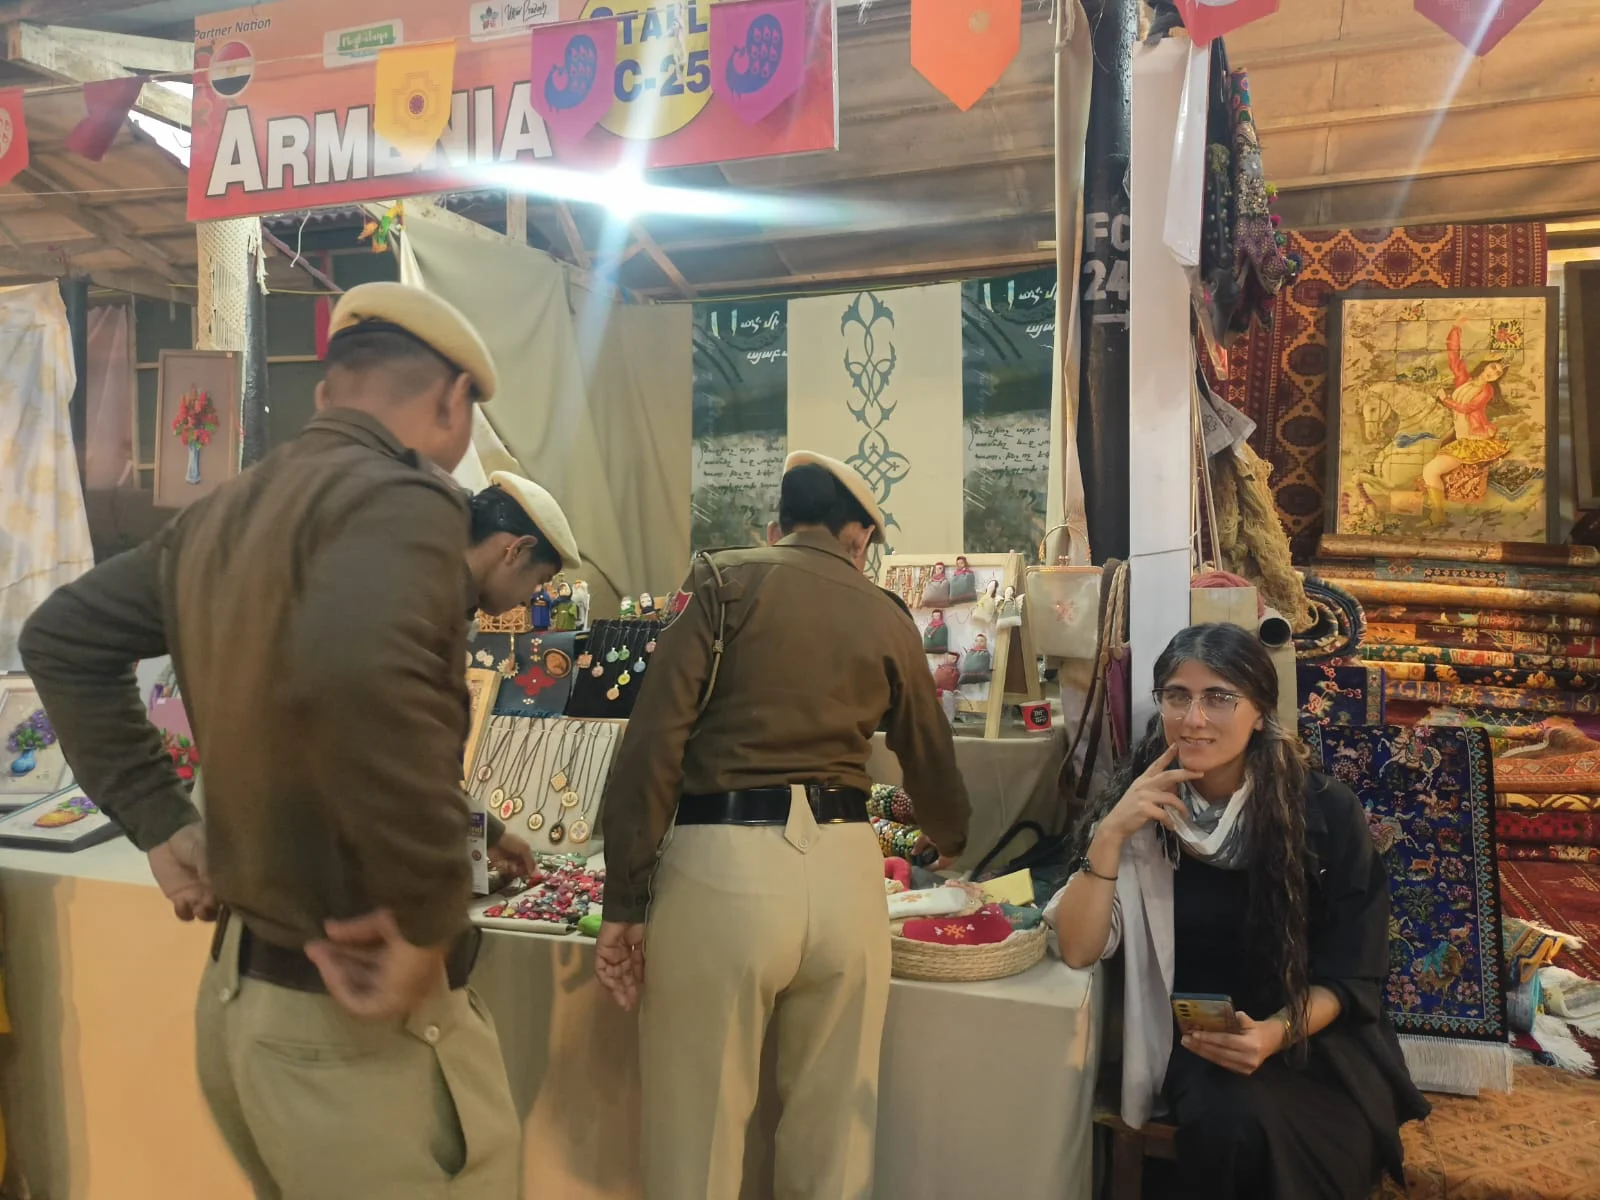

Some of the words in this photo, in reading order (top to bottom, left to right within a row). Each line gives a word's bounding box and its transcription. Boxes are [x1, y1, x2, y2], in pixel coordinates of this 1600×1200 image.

[194, 26, 232, 40] Partner
[235, 18, 271, 33] Nation
[613, 49, 711, 102] C-25
[1084, 259, 1130, 301] 24
